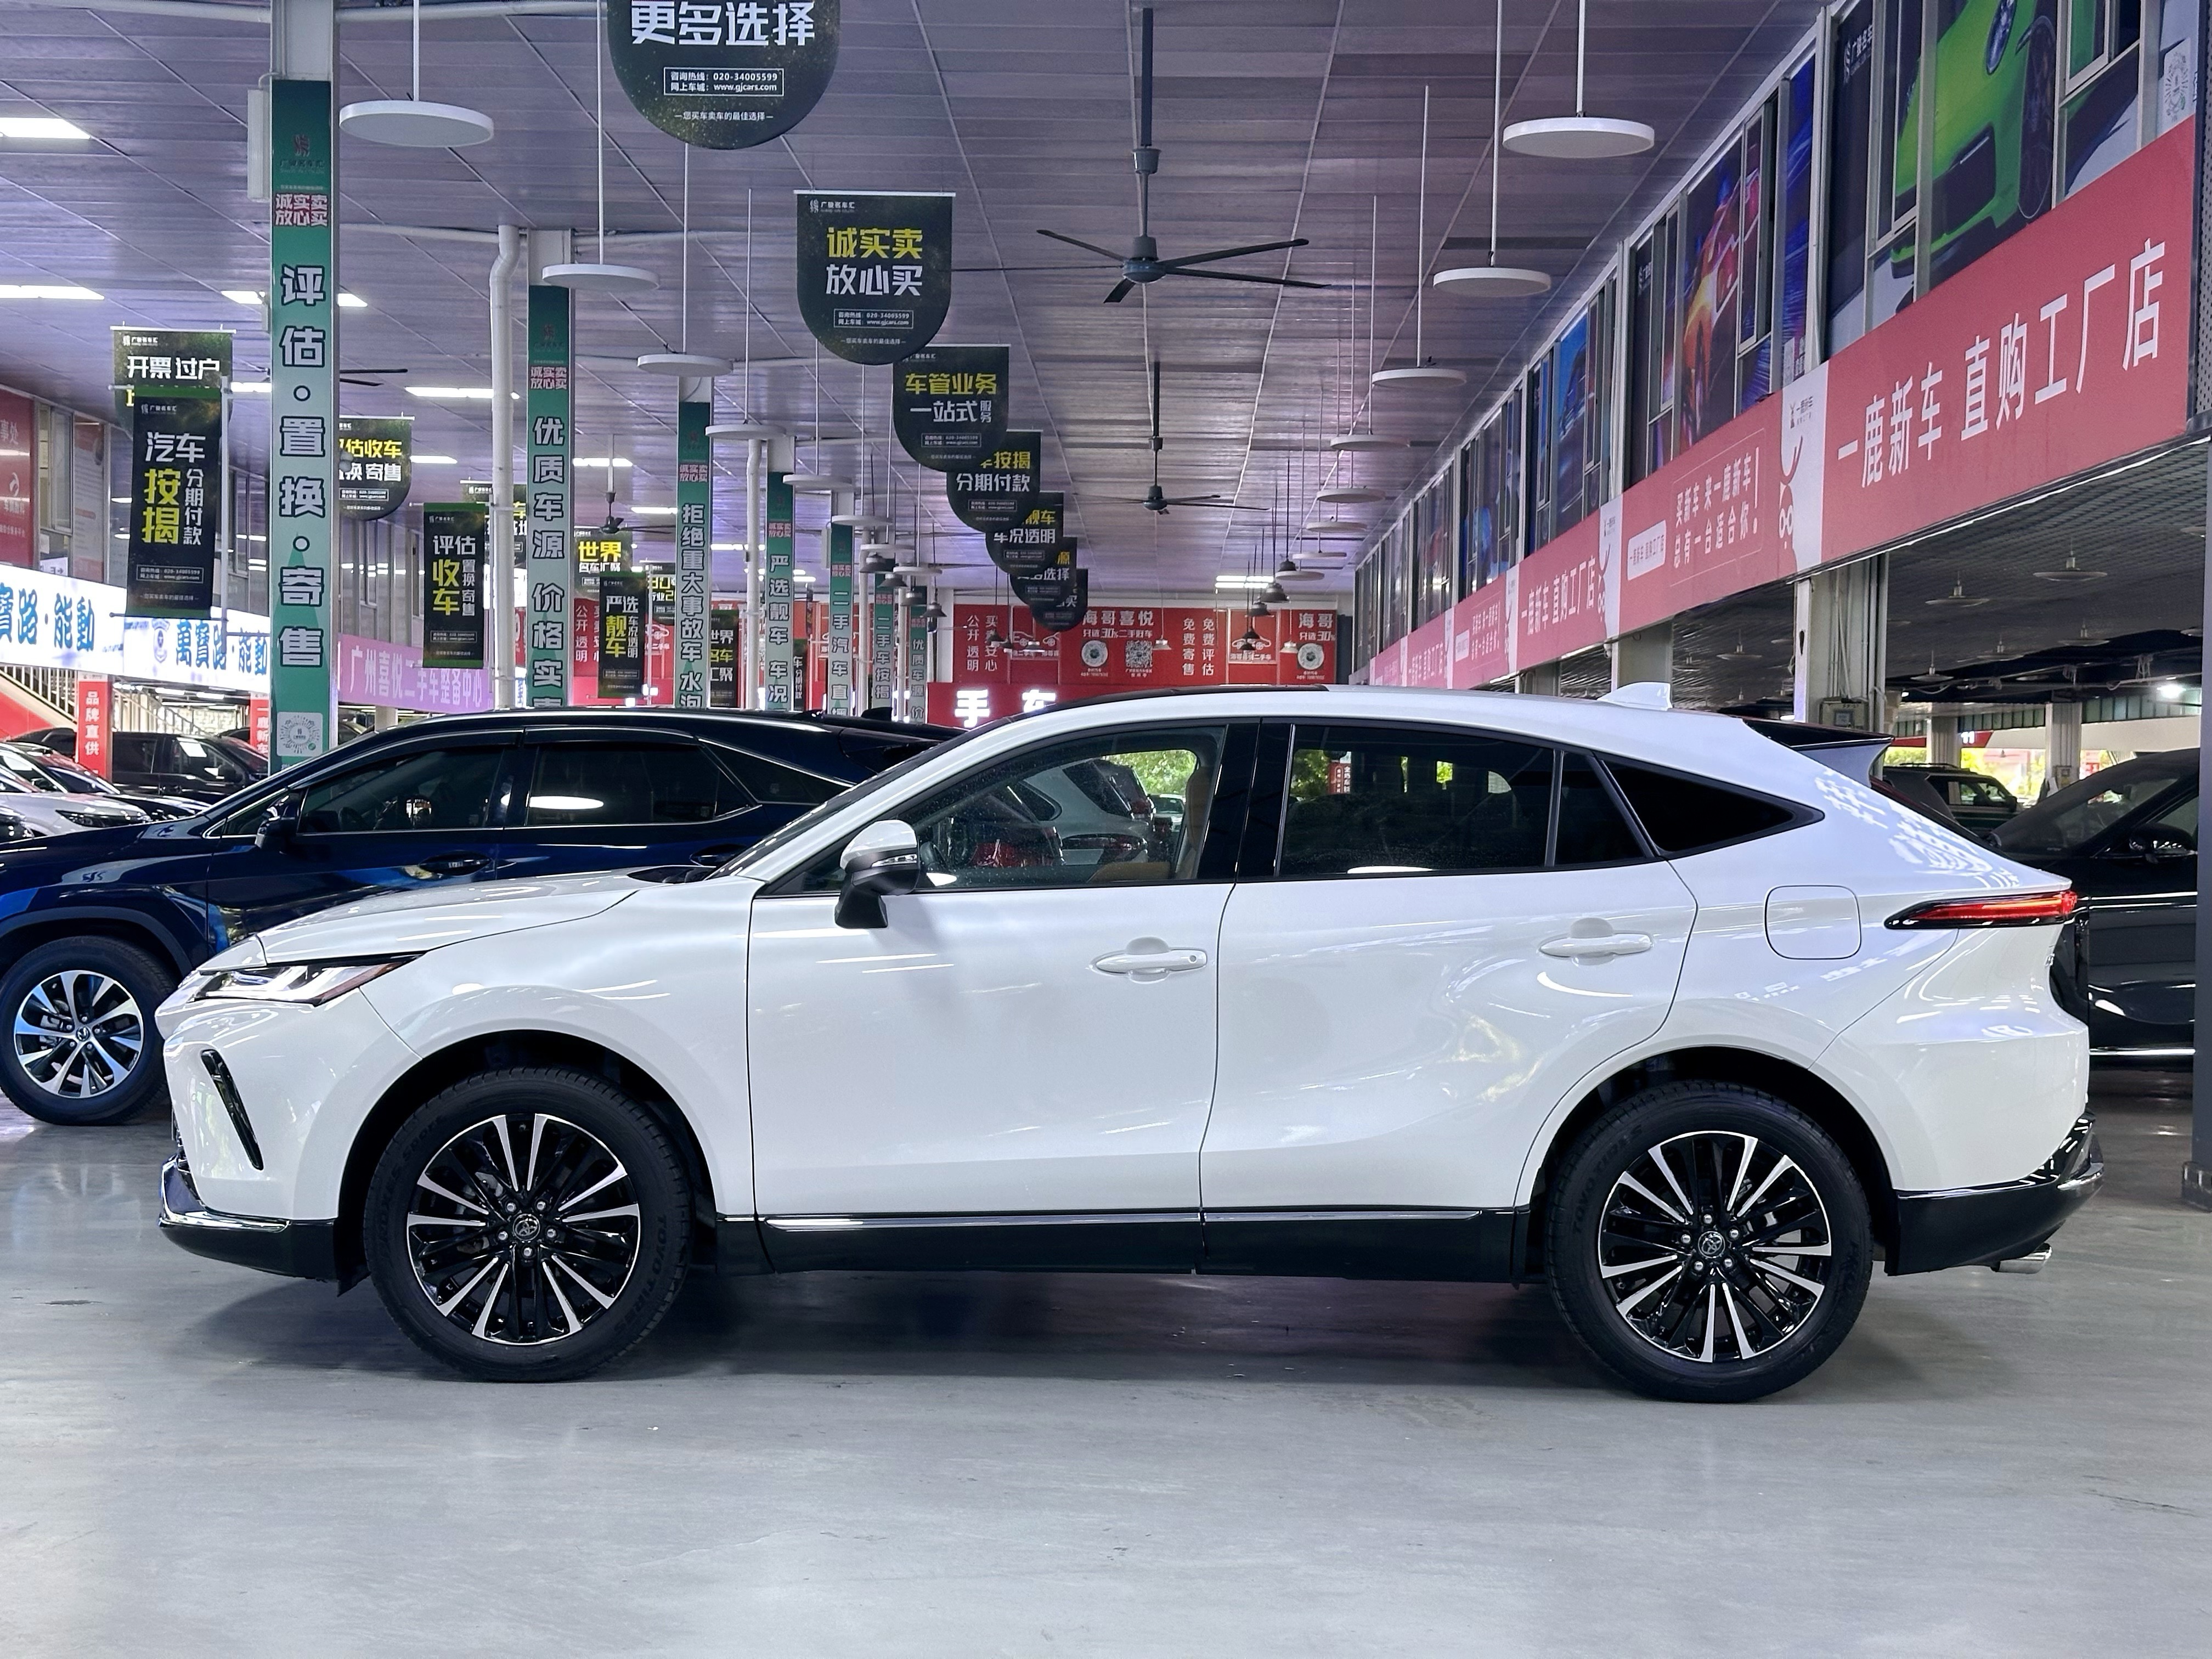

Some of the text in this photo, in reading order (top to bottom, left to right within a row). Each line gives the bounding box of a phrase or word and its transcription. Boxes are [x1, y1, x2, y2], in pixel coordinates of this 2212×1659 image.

[631, 0, 815, 46] 更多选择
[713, 72, 778, 81] 020-34005599
[713, 83, 777, 93] www.gjcars.com
[827, 227, 923, 259] 诚实卖
[826, 264, 923, 296] 放心买
[127, 356, 220, 380] 开票 过户
[1838, 238, 2165, 488] 一鹿新车 直购工厂店
[905, 373, 997, 395] 车管业务
[910, 400, 992, 424] 一站式 服务
[145, 431, 206, 462] 汽车
[365, 463, 402, 482] 寄售
[532, 416, 566, 558] 优质车源
[956, 473, 1030, 492] 分期付款
[141, 468, 182, 545] 按揭
[182, 469, 205, 546] 分期付款
[432, 535, 476, 555] 评估
[578, 541, 622, 562] 世界
[432, 559, 460, 616] 收车
[681, 504, 704, 661] 拒绝重大事故车
[1017, 567, 1070, 580] 选择
[606, 595, 639, 613] 严选
[769, 555, 790, 645] 严选靓车
[1082, 610, 1154, 627] 海哥喜悦
[1298, 613, 1333, 629] 海哥
[605, 615, 627, 658] 靓车
[1182, 618, 1195, 676] 免费寄售
[1201, 618, 1215, 676] 免费评估
[85, 690, 100, 756] 品牌直供
